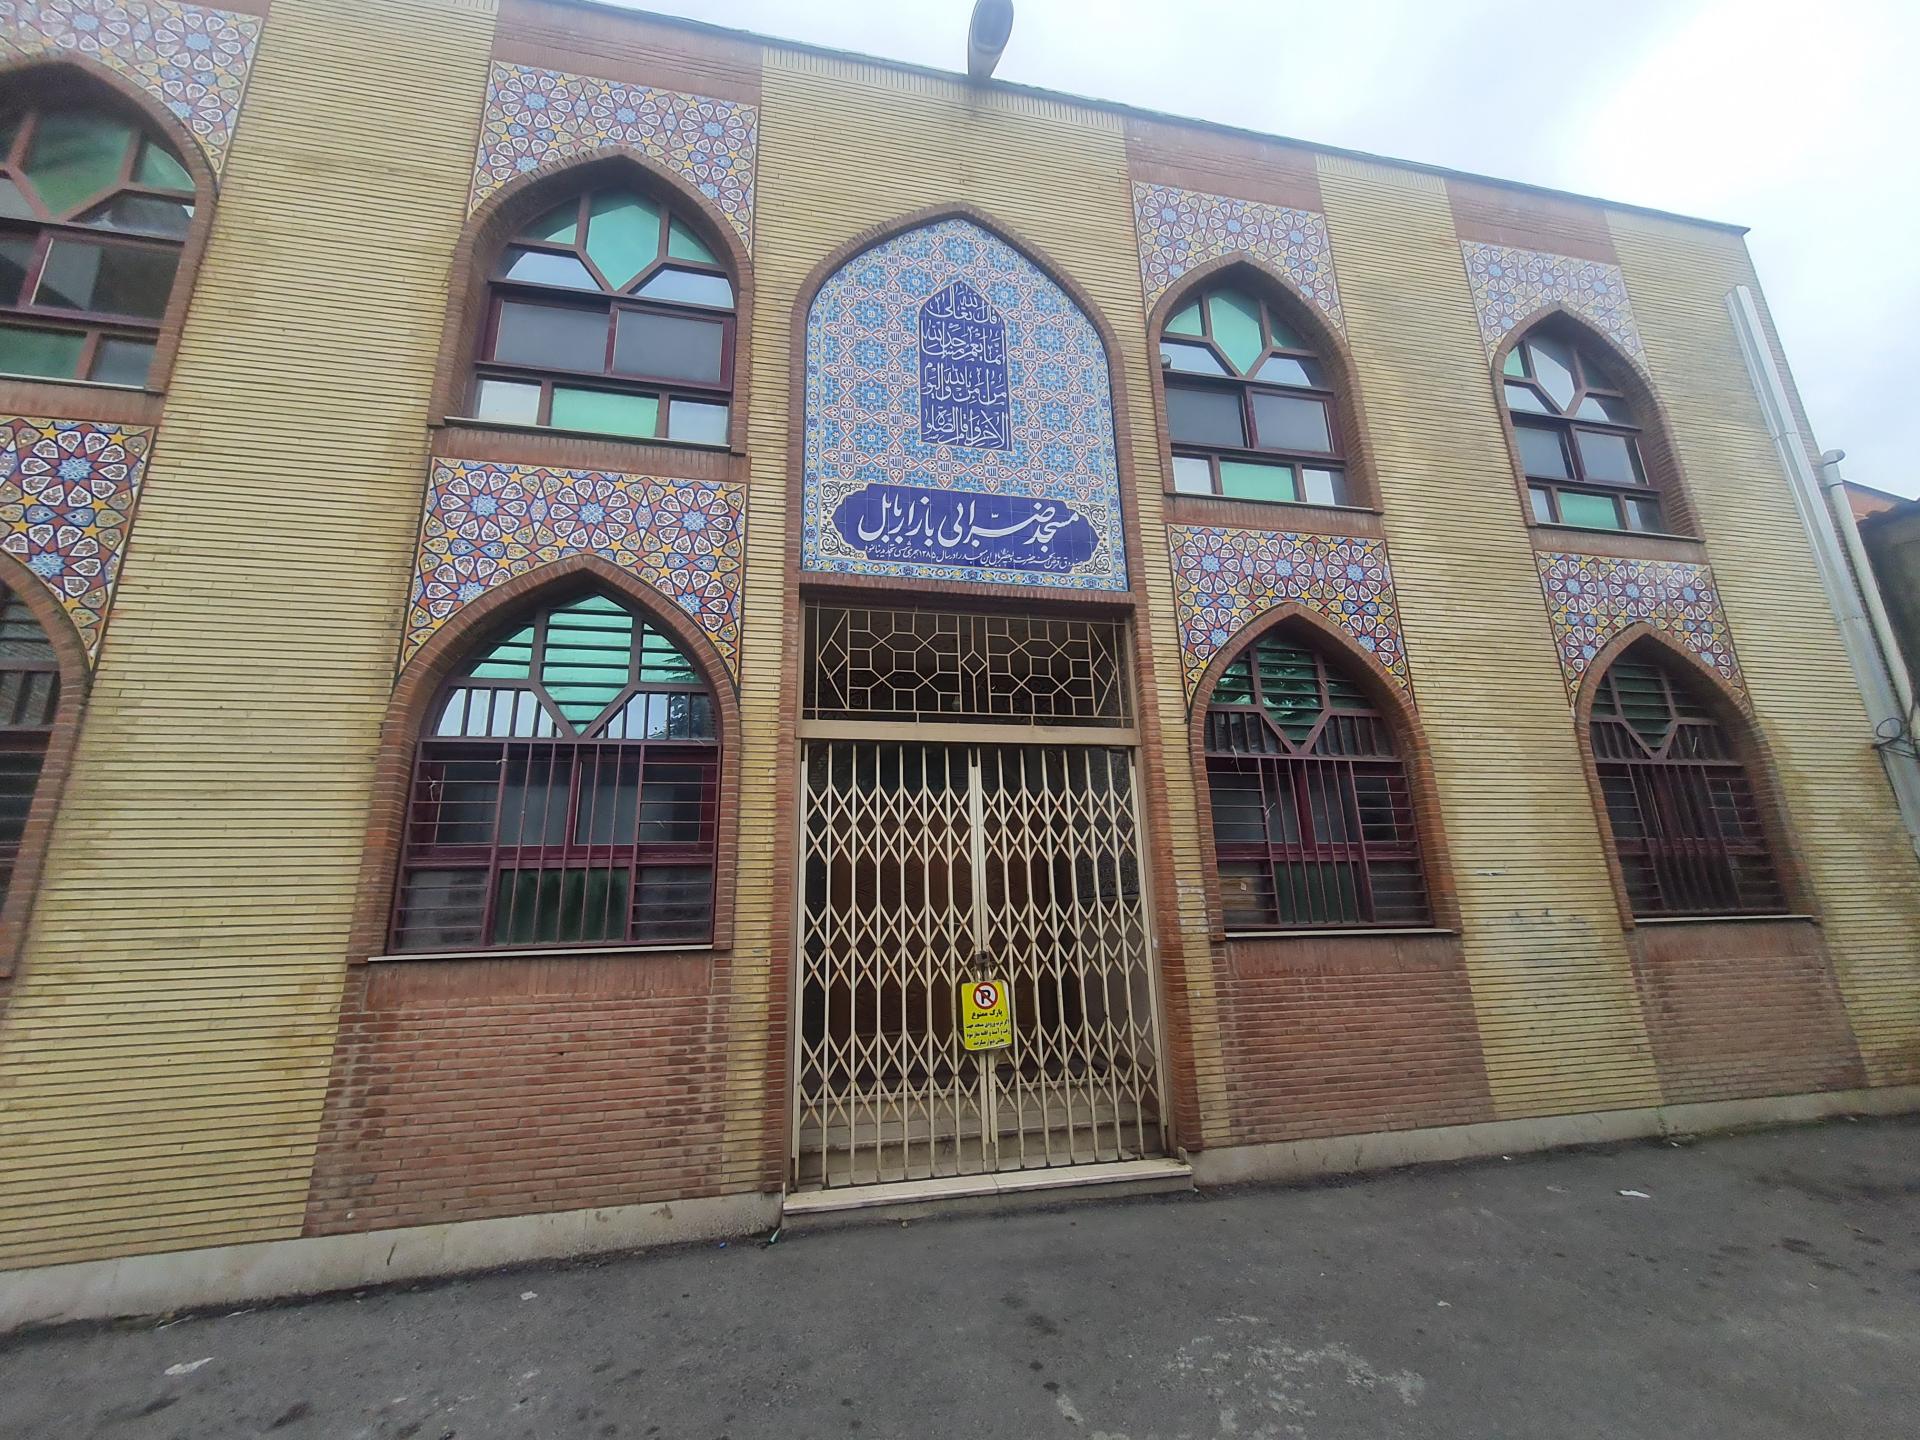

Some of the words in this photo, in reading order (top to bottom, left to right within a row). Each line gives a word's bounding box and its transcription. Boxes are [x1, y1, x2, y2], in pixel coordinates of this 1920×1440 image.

[857, 492, 903, 545] بابل
[888, 496, 935, 547] بازار
[1023, 511, 1080, 553] مسجد
[936, 550, 950, 562] سال
[989, 1009, 1003, 1018] پارک
